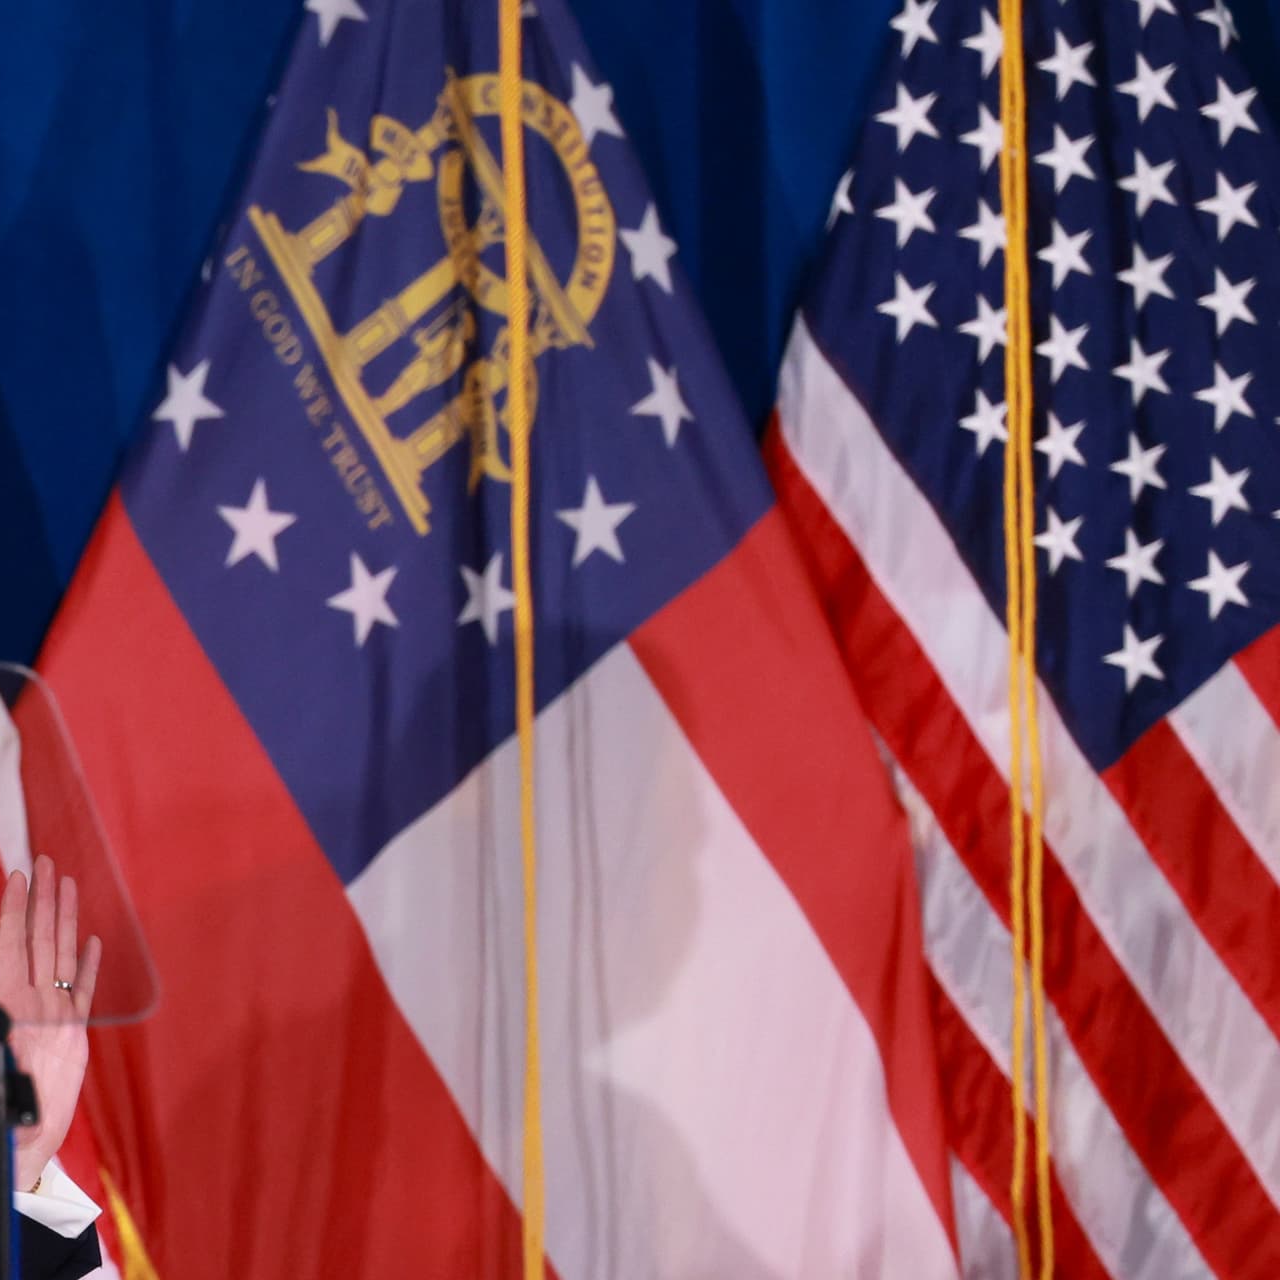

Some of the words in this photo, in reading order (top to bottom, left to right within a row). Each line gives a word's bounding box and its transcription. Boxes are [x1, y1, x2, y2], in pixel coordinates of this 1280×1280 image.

[481, 81, 606, 290] CNSTITUTION
[225, 245, 264, 291] IN
[249, 289, 303, 366] GOD
[294, 363, 332, 427] WE
[322, 421, 393, 531] TRUST
